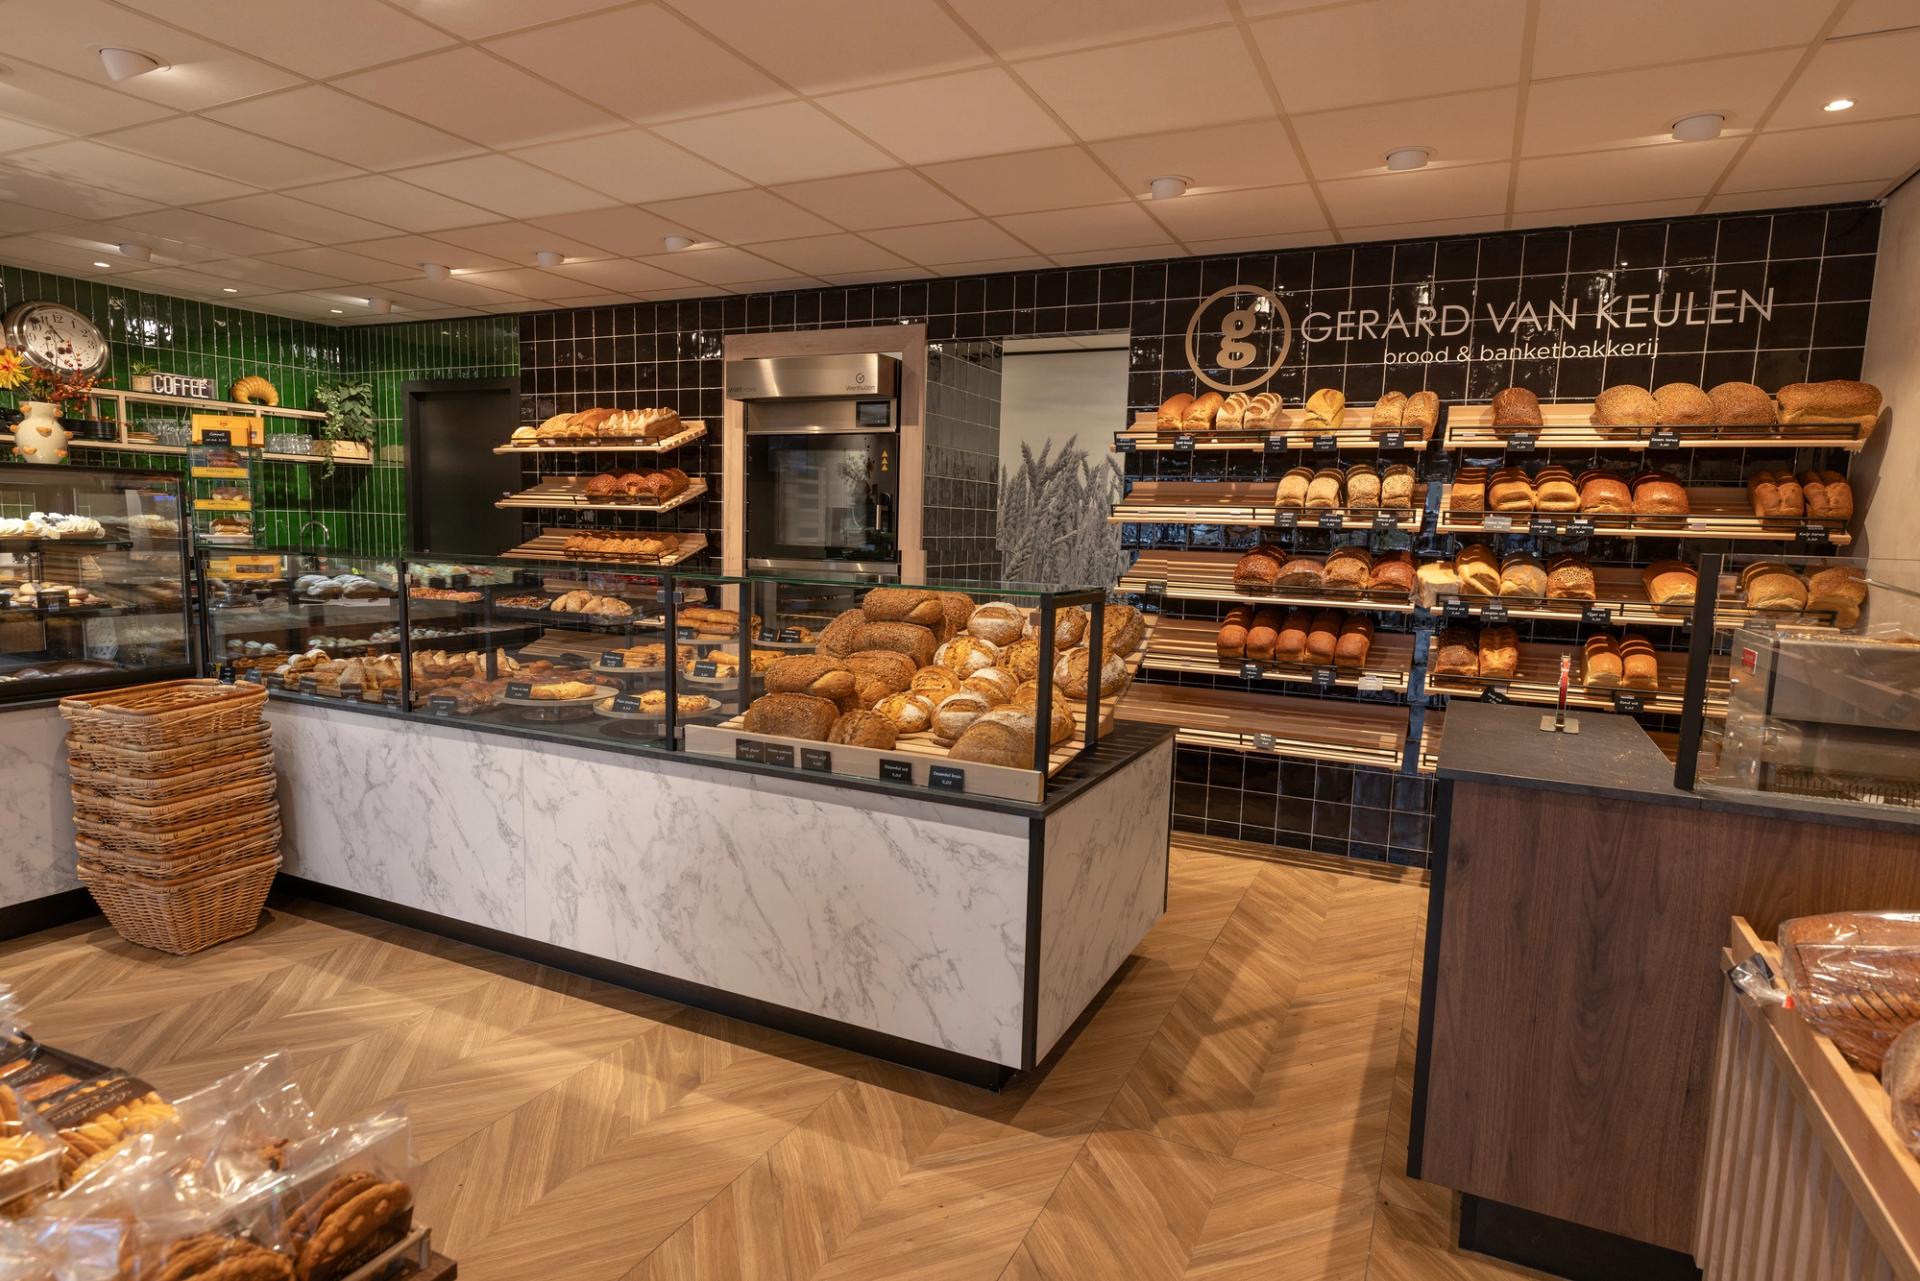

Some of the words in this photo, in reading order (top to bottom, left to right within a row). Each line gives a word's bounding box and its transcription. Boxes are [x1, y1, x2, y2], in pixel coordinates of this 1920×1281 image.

[1300, 304, 1471, 343] GERARD
[1486, 297, 1578, 334] VAN
[1595, 287, 1775, 329] KEULEN
[1384, 346, 1449, 365] brood
[1456, 345, 1472, 362] &
[1480, 337, 1660, 362] banketbakkerij
[153, 374, 209, 399] COFFEE
